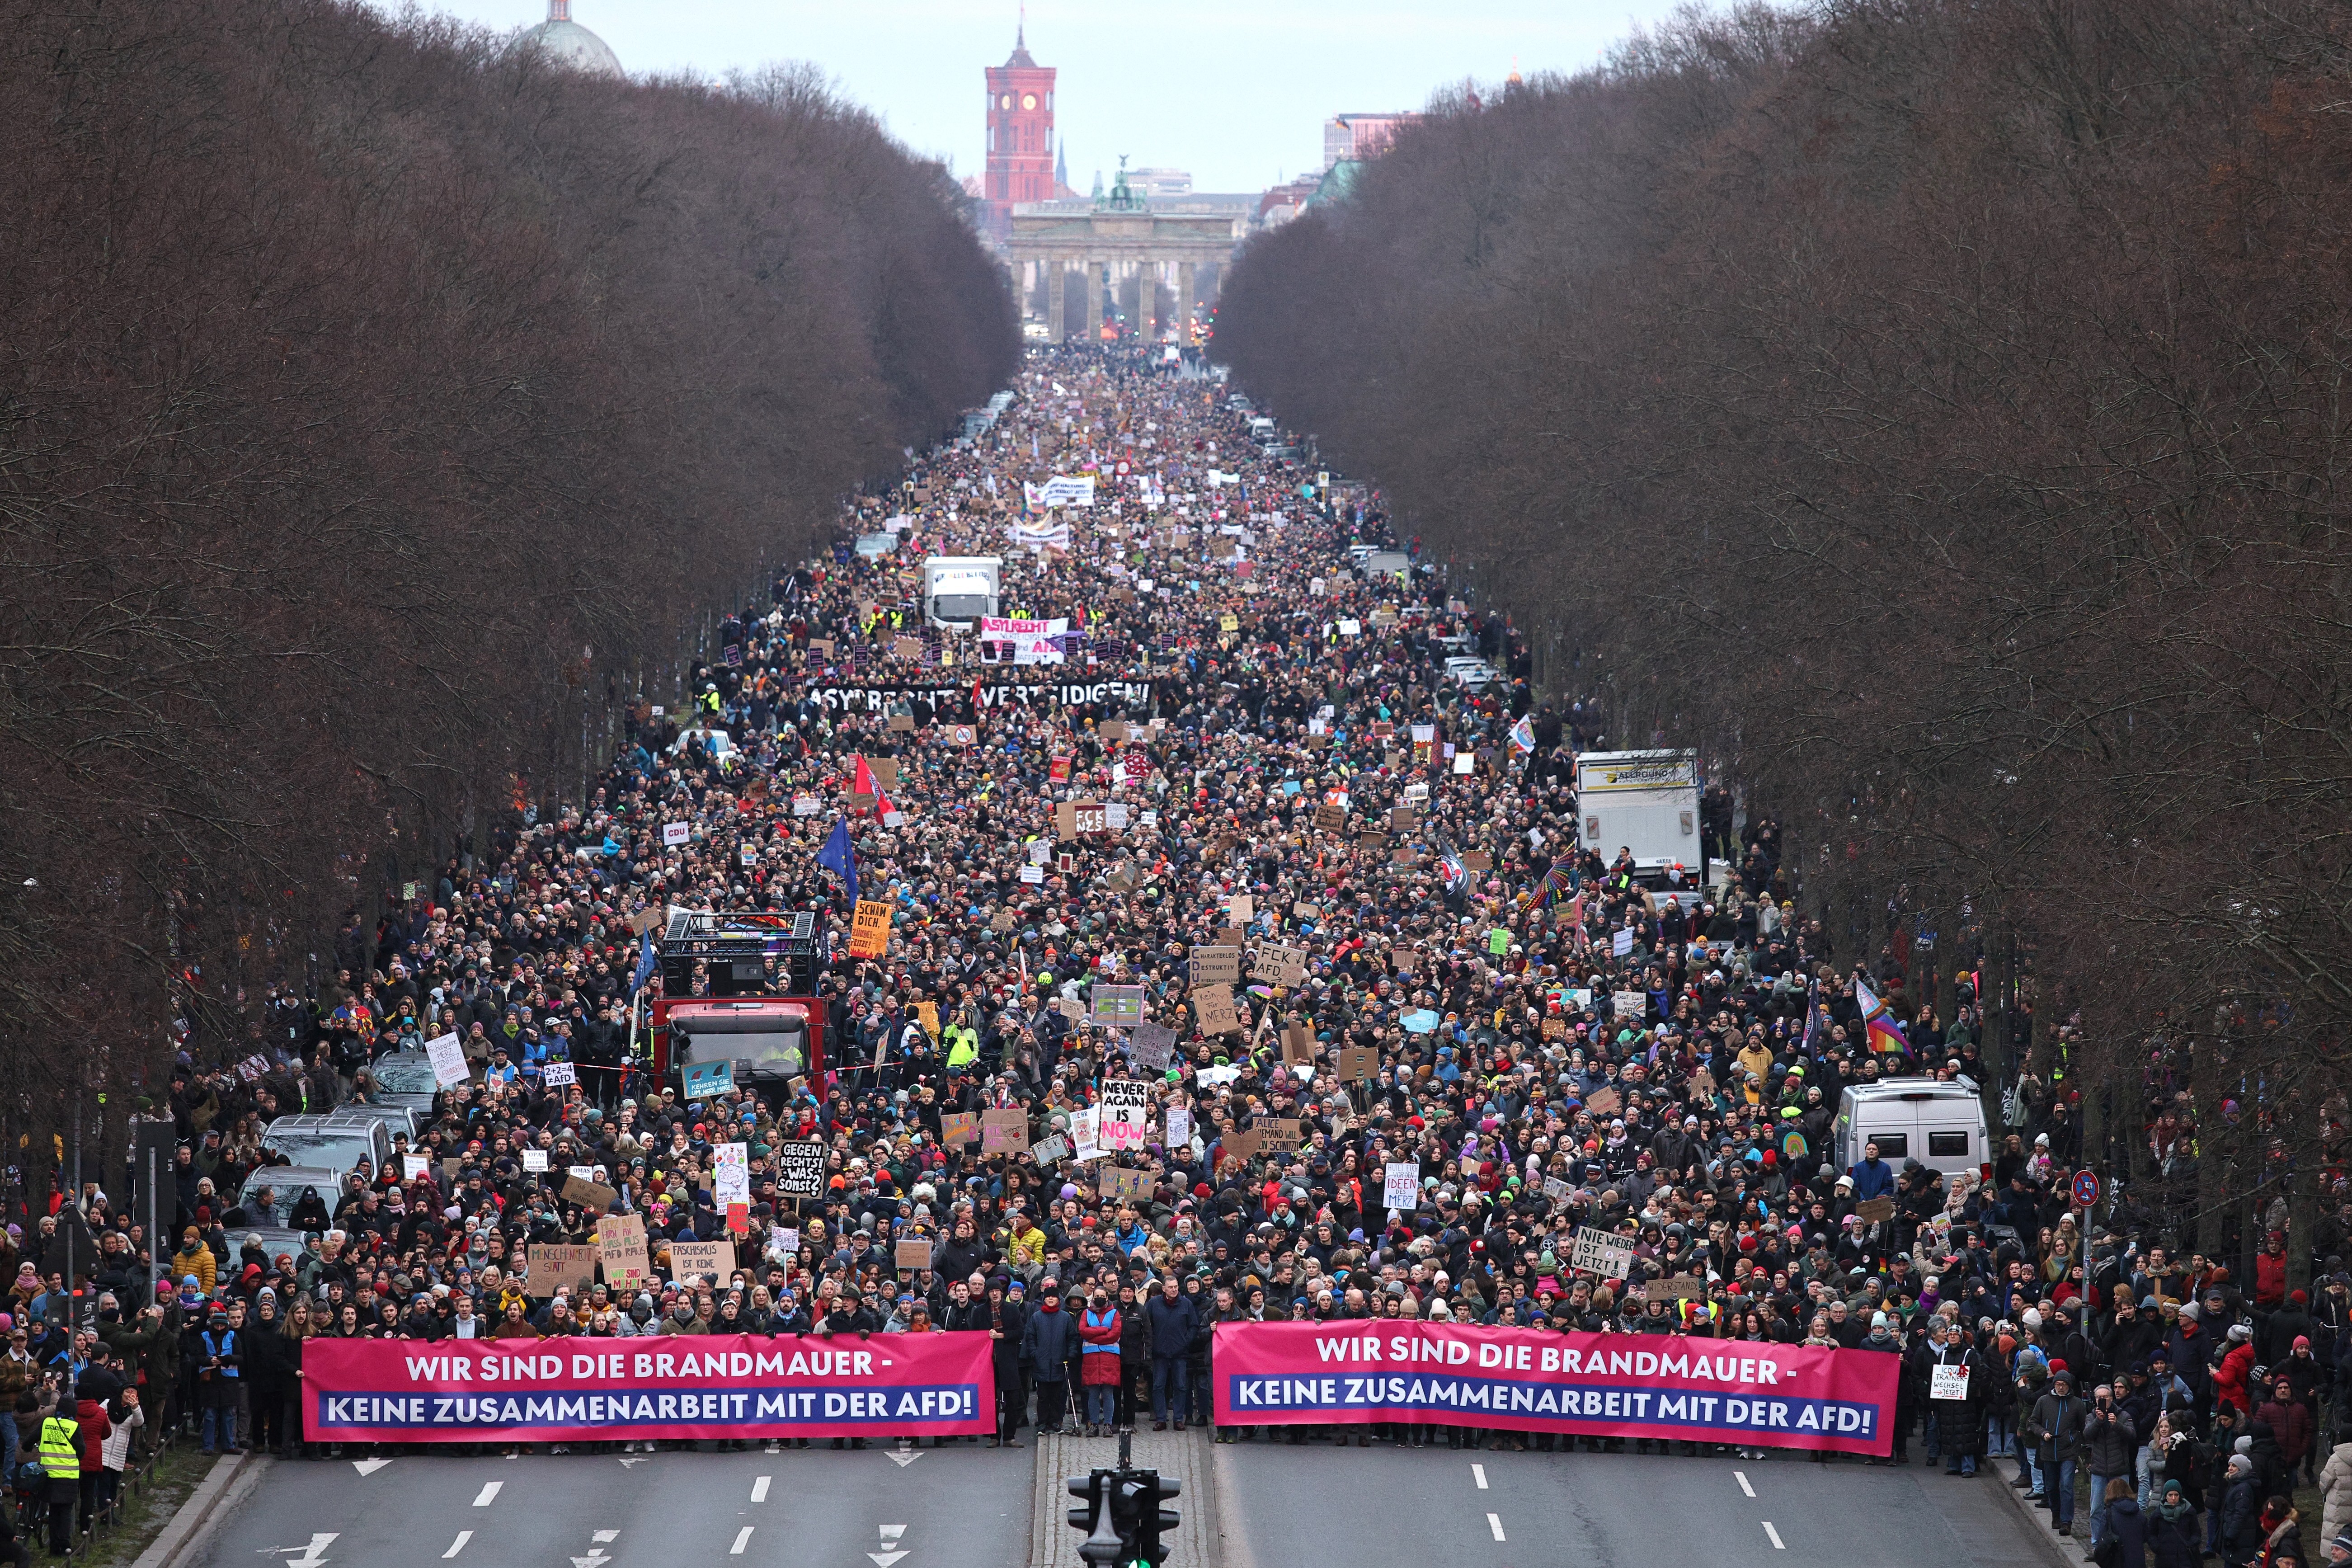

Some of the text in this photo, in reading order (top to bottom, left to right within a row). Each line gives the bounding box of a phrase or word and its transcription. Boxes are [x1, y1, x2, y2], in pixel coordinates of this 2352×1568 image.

[982, 616, 1049, 633] ASYLRECHT
[1619, 770, 1668, 779] ALLROUND
[1076, 810, 1104, 823] FCK
[669, 828, 685, 837] CDU
[1077, 821, 1102, 832] NZS
[859, 903, 886, 918] SCHÄM
[858, 915, 880, 928] DICH,
[852, 928, 876, 939] ZÜNDEL-
[850, 938, 871, 948] FRITZE!
[1192, 949, 1235, 959] CHARAKTERLOS
[1262, 947, 1290, 964] FCK
[1192, 961, 1234, 971] DESTRUKTIV
[1256, 965, 1281, 976] AFD
[1200, 992, 1217, 1000] Kein
[1206, 1008, 1234, 1025] MERZ
[437, 1048, 453, 1060] MERZ
[439, 1063, 466, 1078] VERHINDERN
[545, 1065, 572, 1075] 2+2=4
[691, 1081, 717, 1090] KEHREN
[717, 1083, 733, 1093] MERZ!
[1104, 1083, 1145, 1096] NEVER
[1104, 1096, 1145, 1108] AGAIN
[1072, 1111, 1088, 1120] MEHR
[1116, 1109, 1129, 1122] IS
[1256, 1119, 1282, 1129] ALICE,
[985, 1125, 1001, 1136] FCK
[1102, 1121, 1144, 1140] NOW
[1285, 1130, 1297, 1139] WILL
[783, 1144, 822, 1156] GEGEN
[1037, 1139, 1060, 1153] FCK
[781, 1158, 823, 1173] RECHTS!
[778, 1175, 821, 1196] sonst?
[1133, 1173, 1149, 1186] die
[1388, 1178, 1416, 1189] IDEEN
[1116, 1185, 1137, 1196] sind
[570, 1193, 605, 1211] BRANDMAUER
[1389, 1195, 1413, 1207] MERZ
[601, 1218, 633, 1229] HERZ AUF
[602, 1228, 631, 1239] HIRN AN
[773, 1228, 793, 1237] MERZ
[603, 1235, 640, 1249] HASS AUS
[1581, 1228, 1634, 1251] NIE WIEDER
[605, 1246, 646, 1259] AFD RAUS
[673, 1245, 717, 1256] FASCHISMUS
[1578, 1243, 1599, 1255] IST
[544, 1262, 566, 1272] STATT
[683, 1259, 715, 1268] IST KEINE
[611, 1268, 640, 1278] WIR SIND
[613, 1279, 640, 1288] MEHR!
[1647, 1280, 1698, 1293] WIDERSTAND!
[406, 1357, 472, 1380] WIR
[480, 1356, 562, 1380] SIND
[573, 1355, 624, 1378] DIE
[635, 1351, 873, 1377] BRANDMAUER
[1316, 1337, 1382, 1361] WIR
[1390, 1337, 1470, 1364] SIND
[1480, 1343, 1531, 1370] DIE
[1541, 1348, 1778, 1384] BRANDMAUER
[1936, 1374, 1967, 1382] TRAINER-
[329, 1391, 971, 1422] KEINE ZUSAMMENARBEIT MIT DER AFD!
[1240, 1378, 1870, 1433] KEINE ZUSAMMENARBEIT MIT DER AFD!
